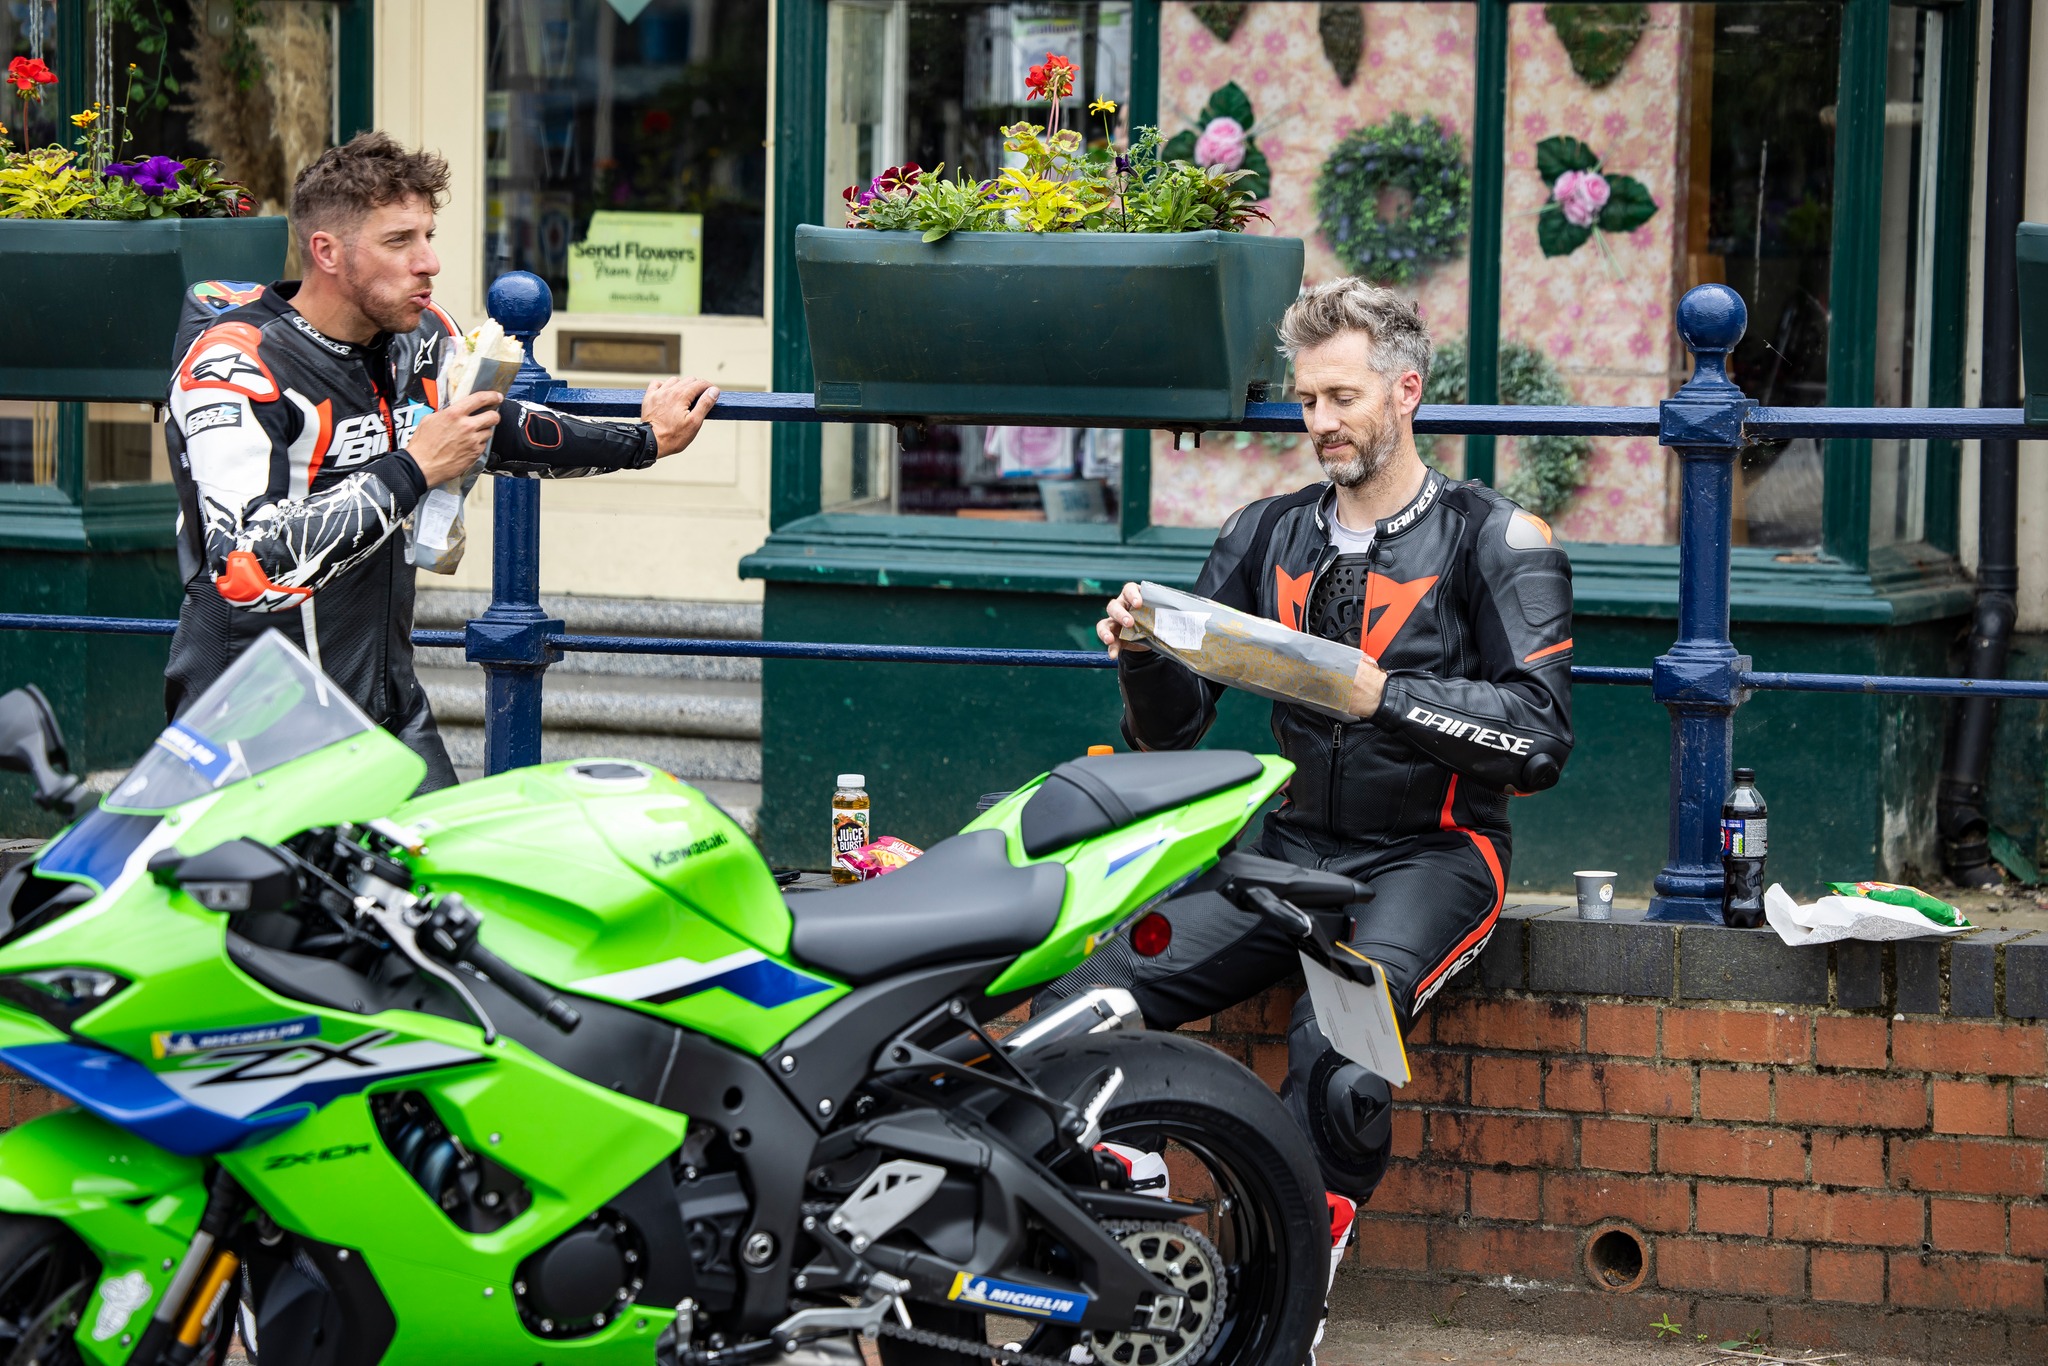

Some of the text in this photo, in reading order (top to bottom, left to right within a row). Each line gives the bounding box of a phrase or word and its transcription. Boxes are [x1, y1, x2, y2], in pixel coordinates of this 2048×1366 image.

[574, 241, 696, 263] Send Flowers
[1387, 480, 1439, 534] DAINESE
[1406, 706, 1535, 756] DAINESE
[650, 830, 729, 870] Kawasaki
[840, 840, 864, 851] BURST
[199, 1023, 304, 1048] MICHELIN
[190, 1029, 396, 1089] ZX
[988, 1288, 1075, 1313] MICHELIN
